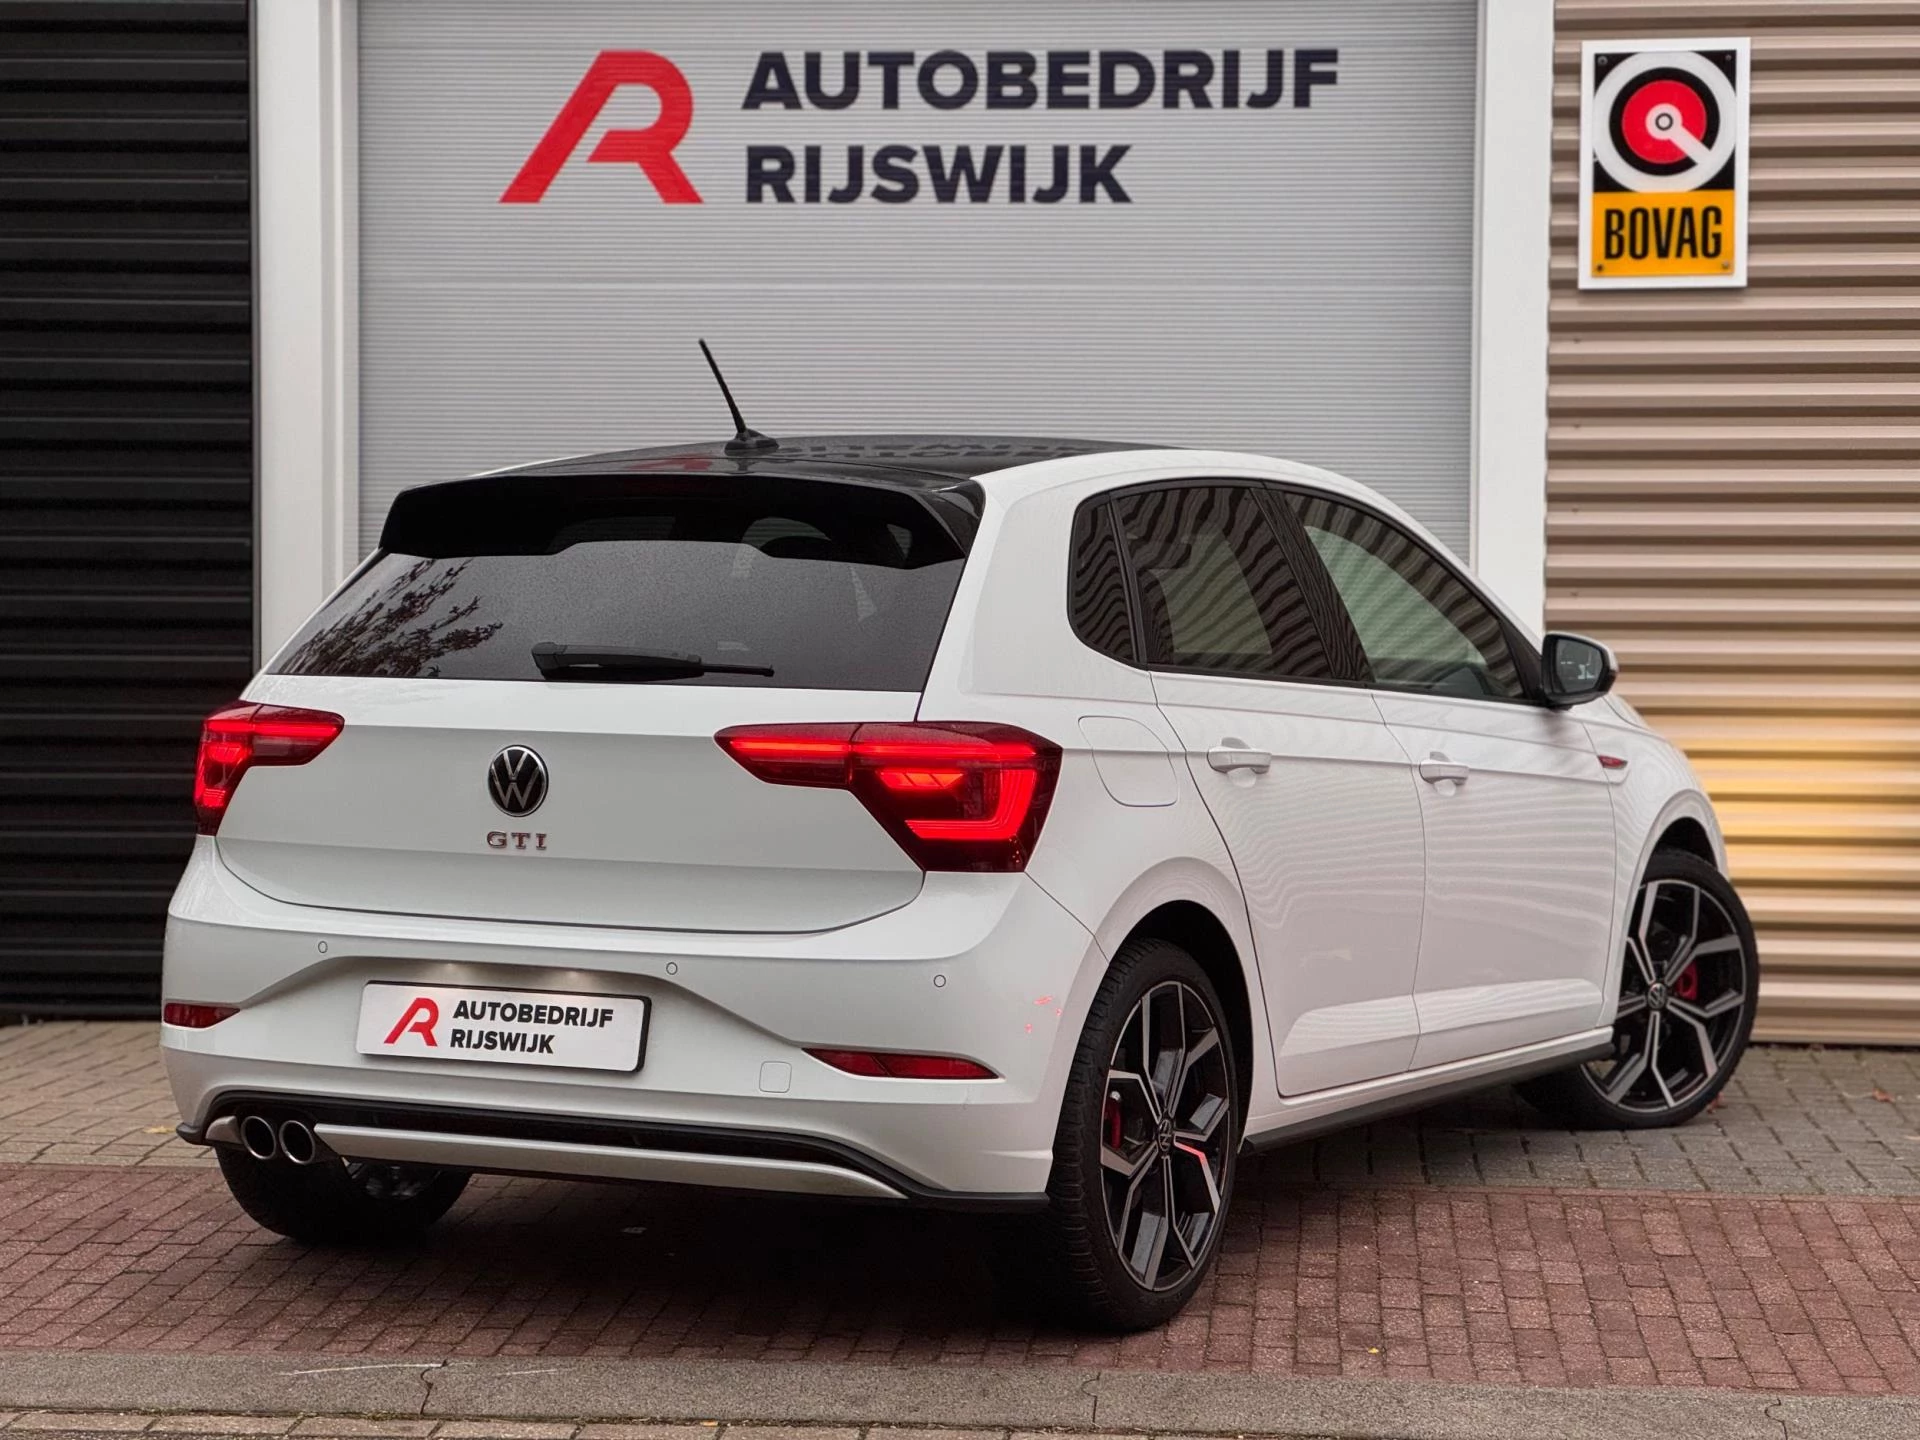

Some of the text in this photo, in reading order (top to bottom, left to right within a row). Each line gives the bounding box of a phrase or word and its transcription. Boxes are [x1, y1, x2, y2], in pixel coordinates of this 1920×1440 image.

[742, 48, 1338, 111] AUTOBEDRIJF
[746, 144, 1133, 204] RIJSWIJK
[1604, 205, 1722, 260] BOVAG
[486, 831, 548, 851] GTI
[452, 999, 614, 1028] AUTOBEDRIJF
[449, 1028, 555, 1054] RIJSWIJK
